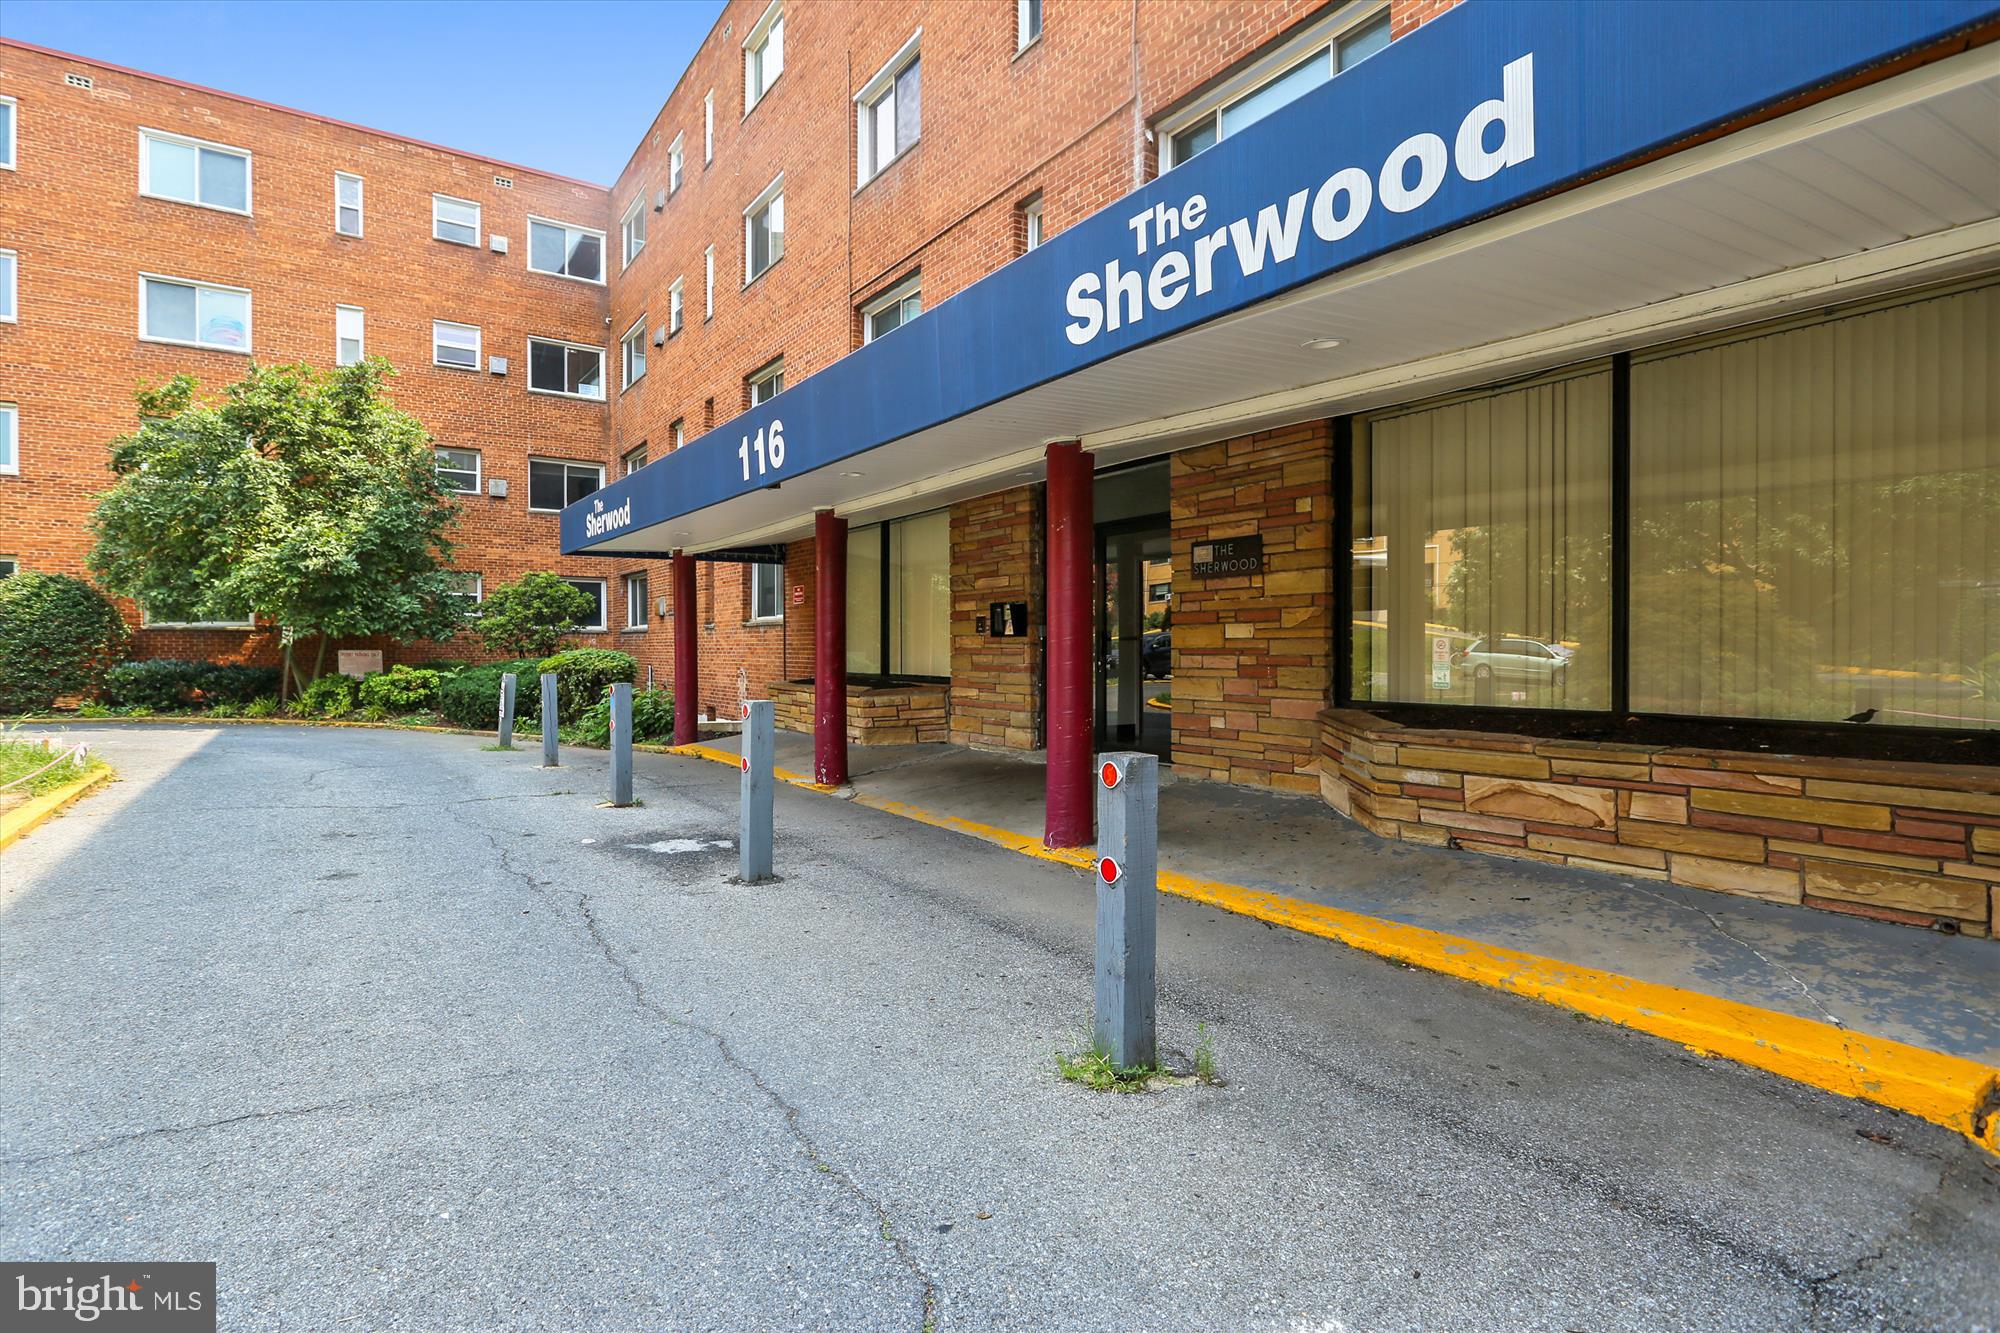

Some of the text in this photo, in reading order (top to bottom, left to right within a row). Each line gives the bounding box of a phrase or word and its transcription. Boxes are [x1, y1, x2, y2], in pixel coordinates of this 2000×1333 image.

[1065, 52, 1535, 345] Sherwood
[1129, 193, 1207, 255] The
[738, 419, 785, 481] 116
[586, 497, 631, 538] Sherwood
[593, 499, 604, 514] The
[1193, 557, 1258, 575] SHERWOOD
[1214, 543, 1234, 557] THE
